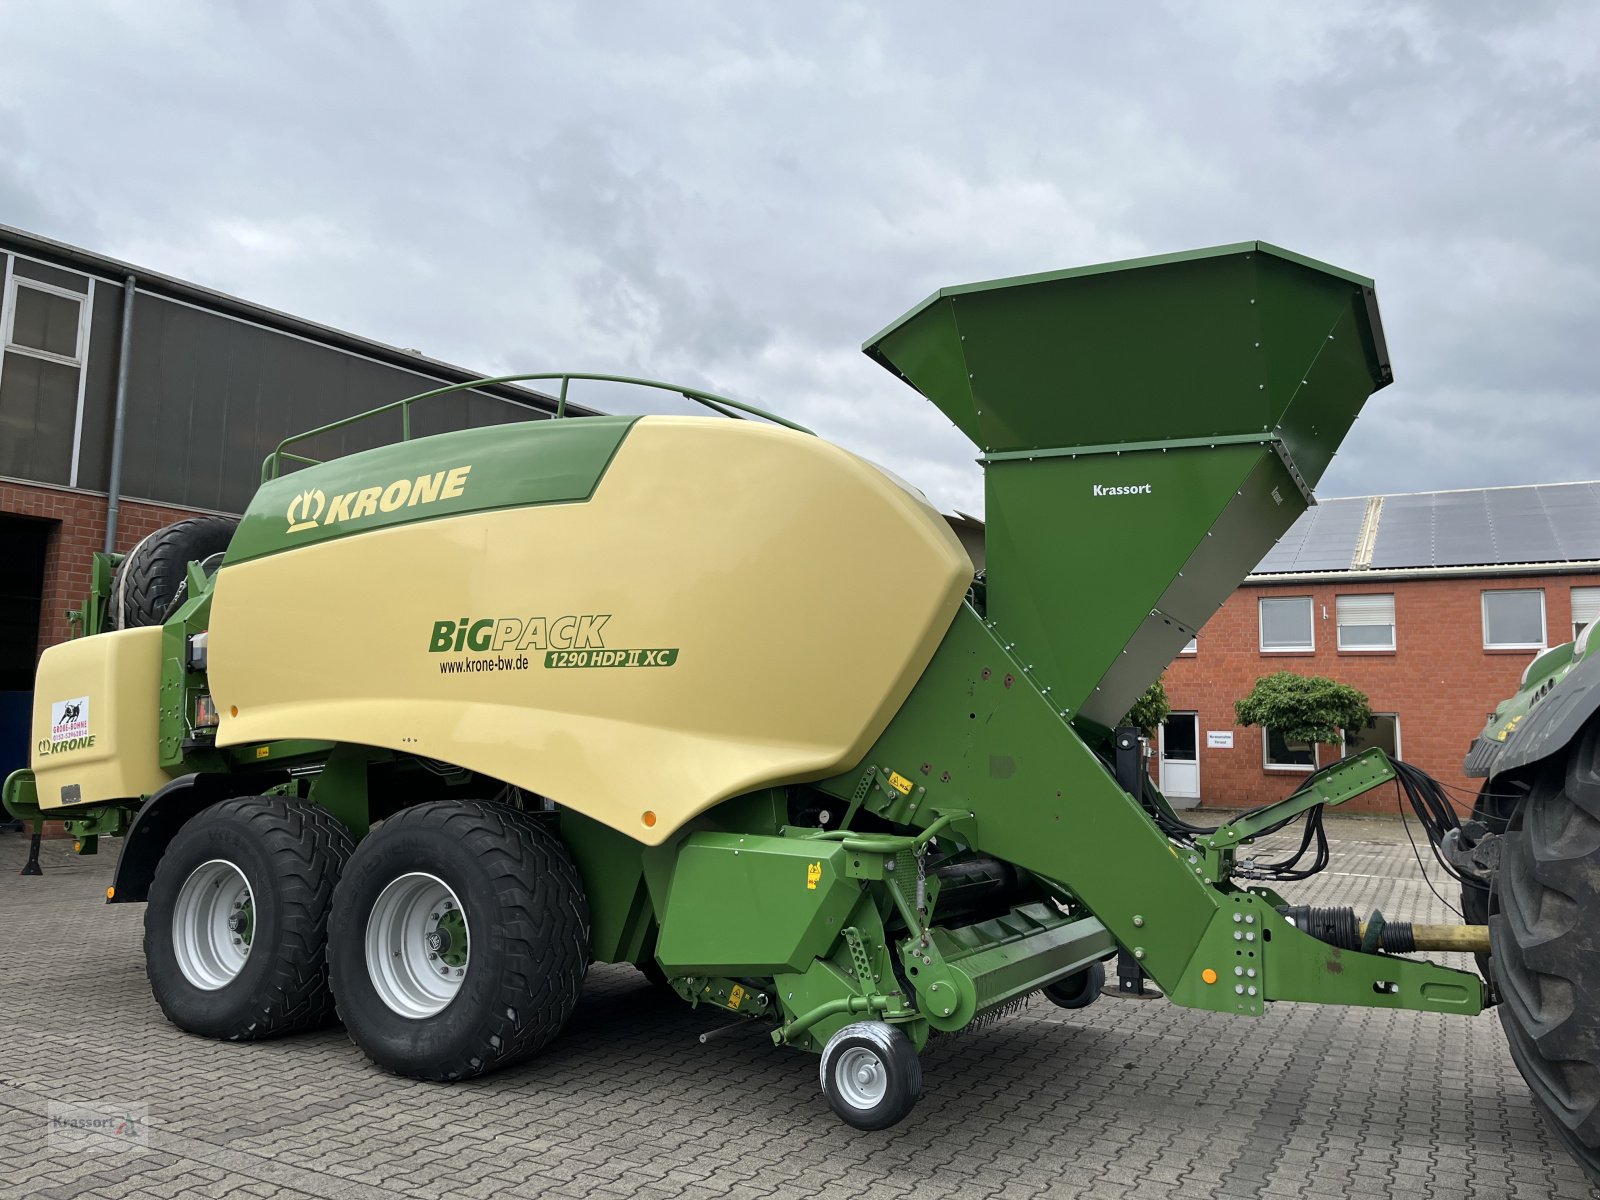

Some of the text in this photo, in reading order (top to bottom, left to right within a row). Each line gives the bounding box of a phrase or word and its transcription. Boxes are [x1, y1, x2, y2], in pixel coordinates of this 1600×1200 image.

[324, 465, 472, 526] KRONE
[1093, 483, 1152, 497] Krassort
[439, 653, 529, 674] www.krone-bw.de
[550, 652, 587, 667] 1290
[646, 650, 670, 666] XC
[51, 735, 96, 755] KRONE
